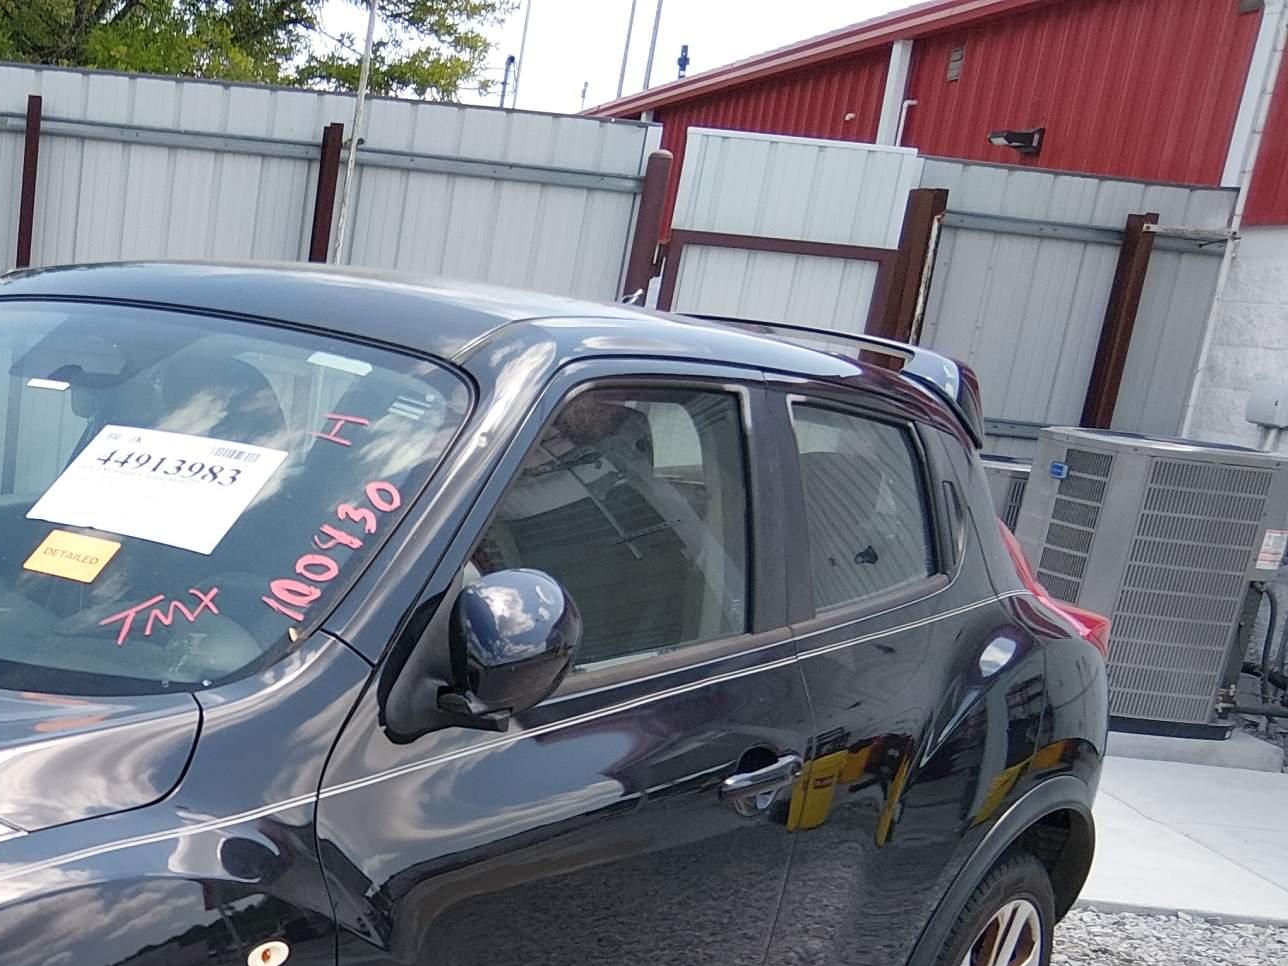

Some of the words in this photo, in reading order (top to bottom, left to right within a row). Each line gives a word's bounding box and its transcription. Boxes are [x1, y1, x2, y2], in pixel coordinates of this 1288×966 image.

[96, 448, 242, 486] 44913983
[42, 546, 100, 566] DETAILED
[262, 481, 401, 621] 100430
